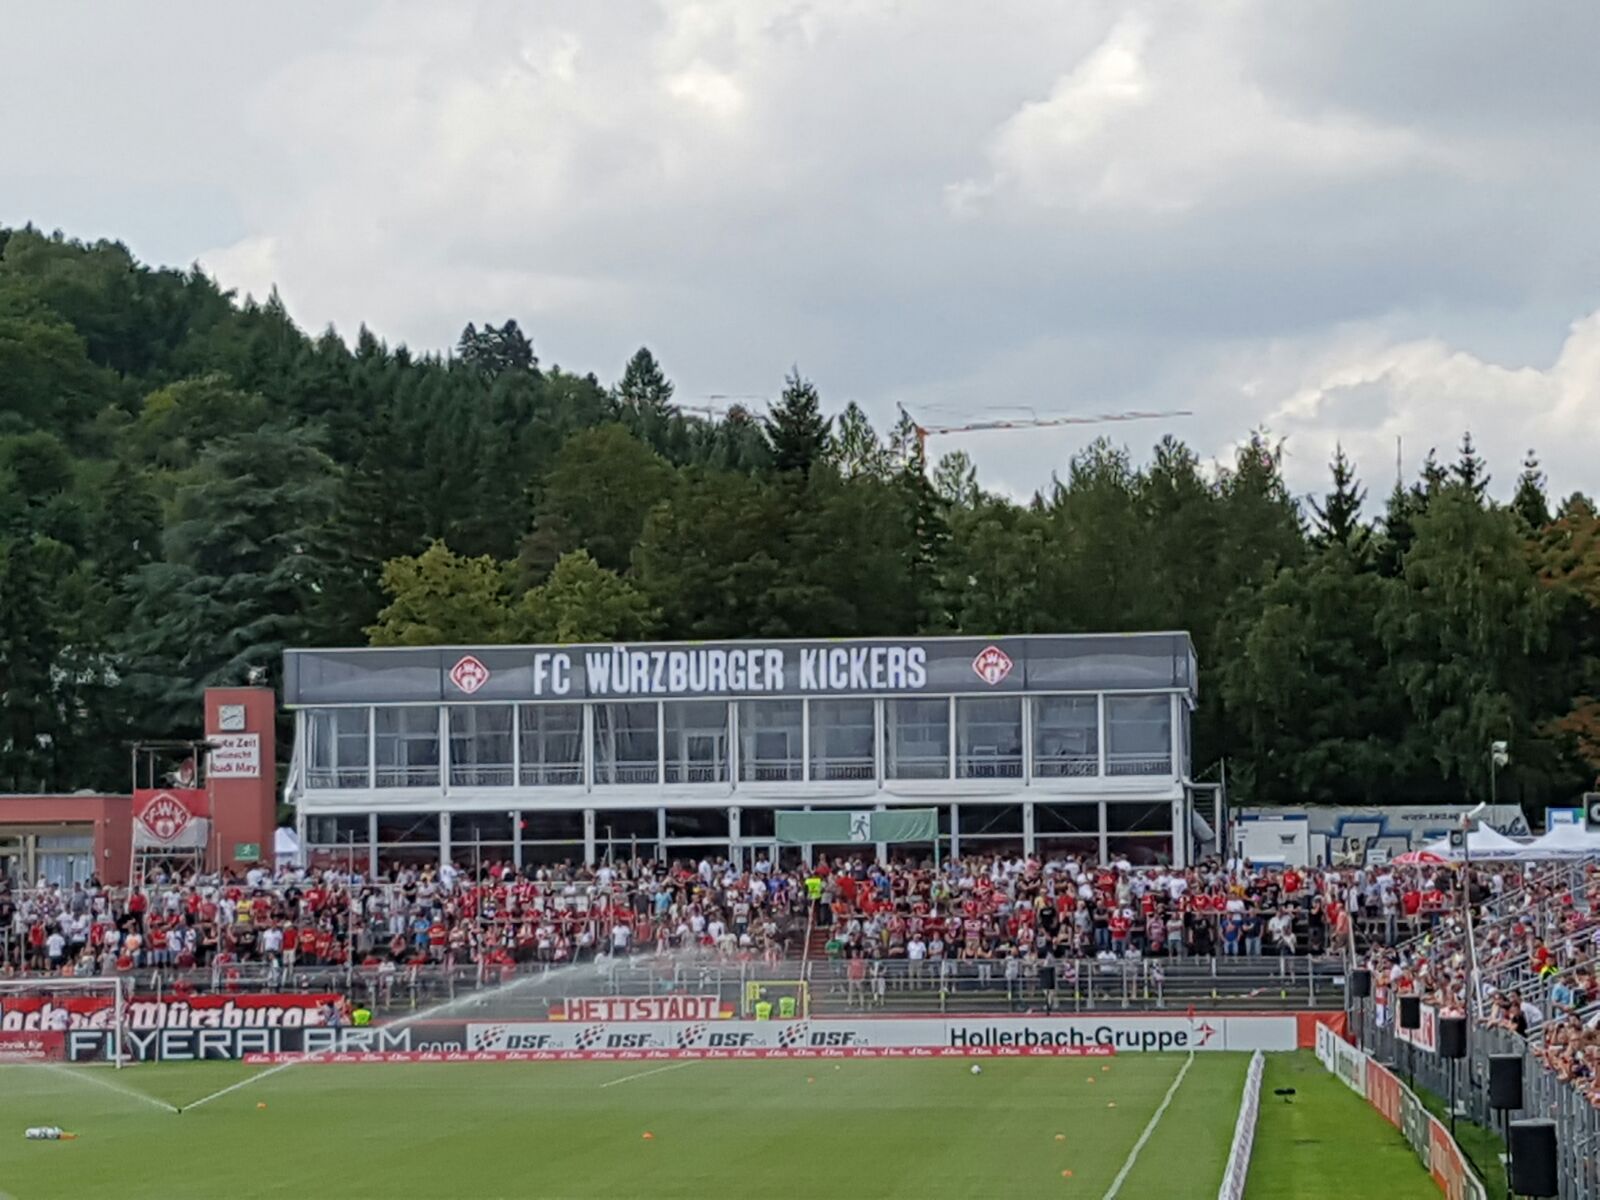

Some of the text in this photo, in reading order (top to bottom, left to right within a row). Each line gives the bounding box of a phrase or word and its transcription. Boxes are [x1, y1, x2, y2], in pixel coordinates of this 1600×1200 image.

[533, 645, 927, 695] FC WÜRZBURGER KICKERS
[567, 997, 717, 1020] HETTSTADT
[70, 1027, 411, 1061] FLYERALARM
[950, 1026, 1188, 1051] Hollerbach-Gruppe
